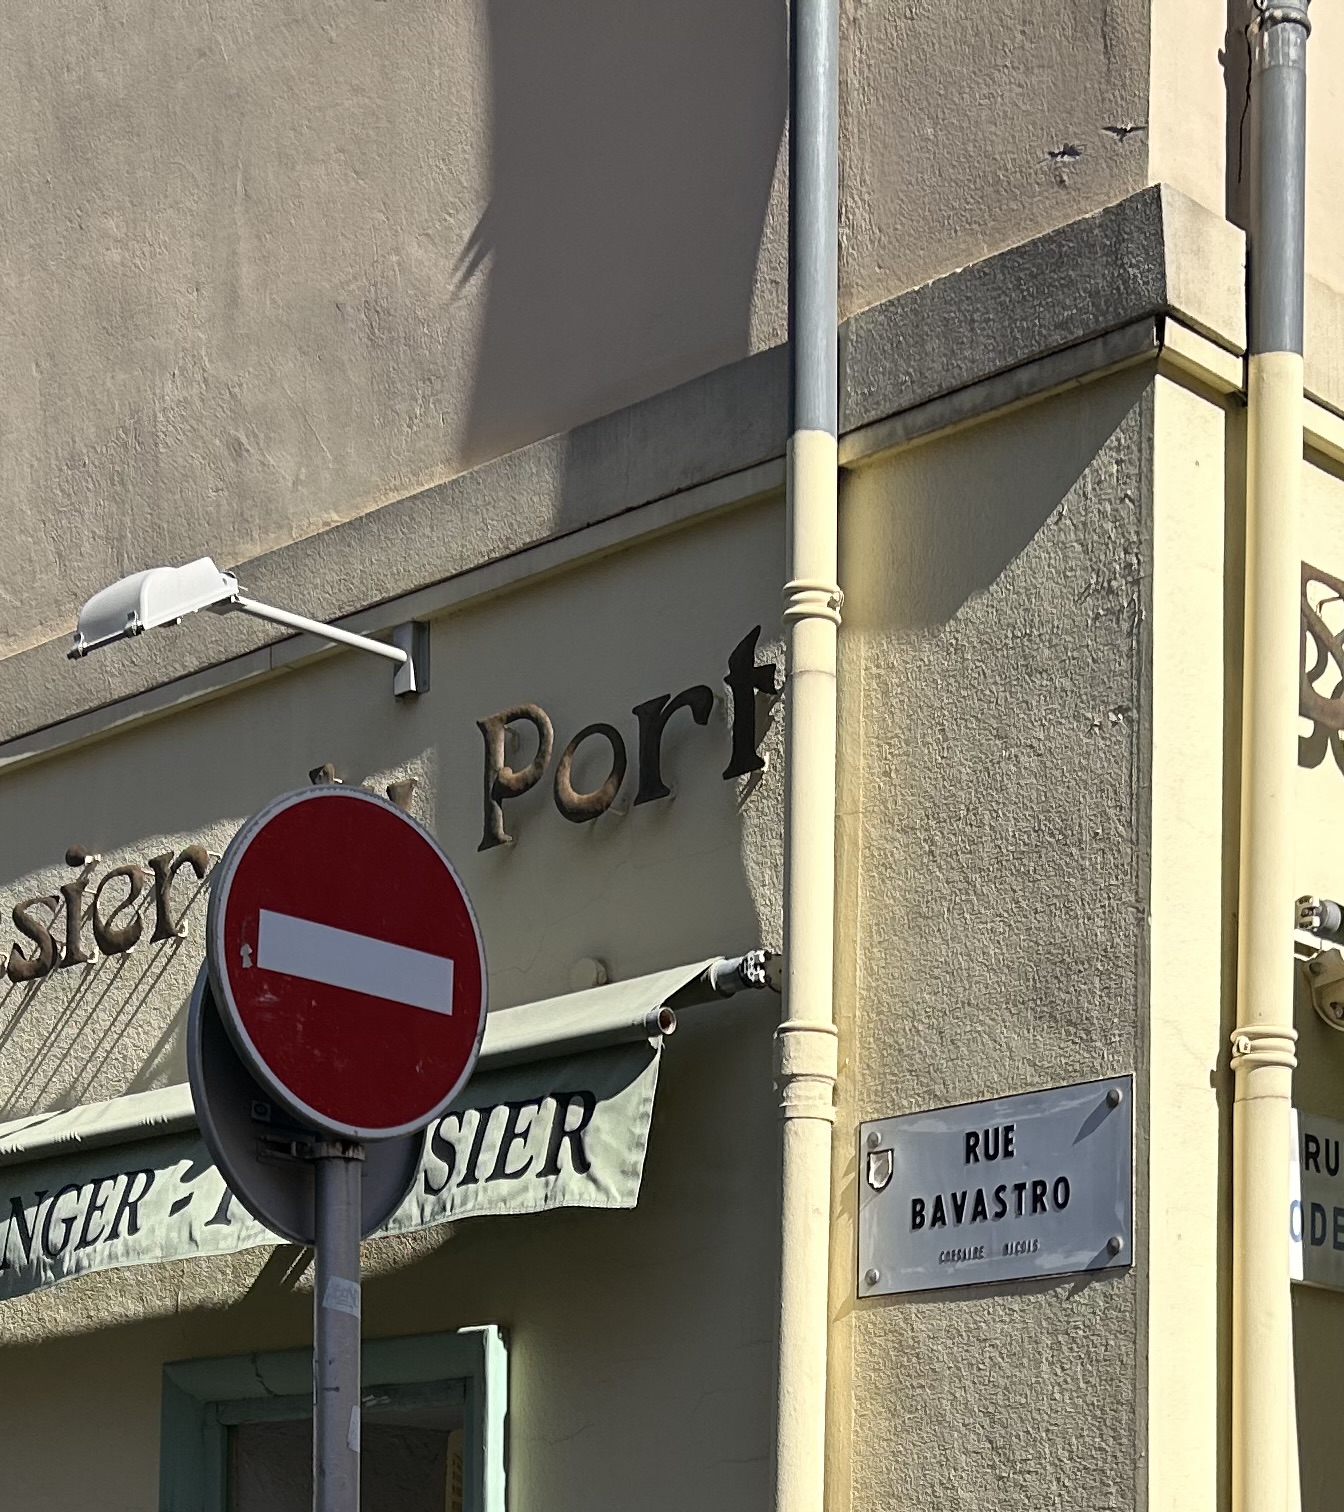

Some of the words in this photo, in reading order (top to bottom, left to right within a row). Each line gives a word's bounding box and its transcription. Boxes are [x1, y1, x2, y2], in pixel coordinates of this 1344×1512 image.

[476, 625, 781, 853] Port
[964, 1123, 1017, 1166] RUE
[910, 1175, 1073, 1232] BAVASTRO
